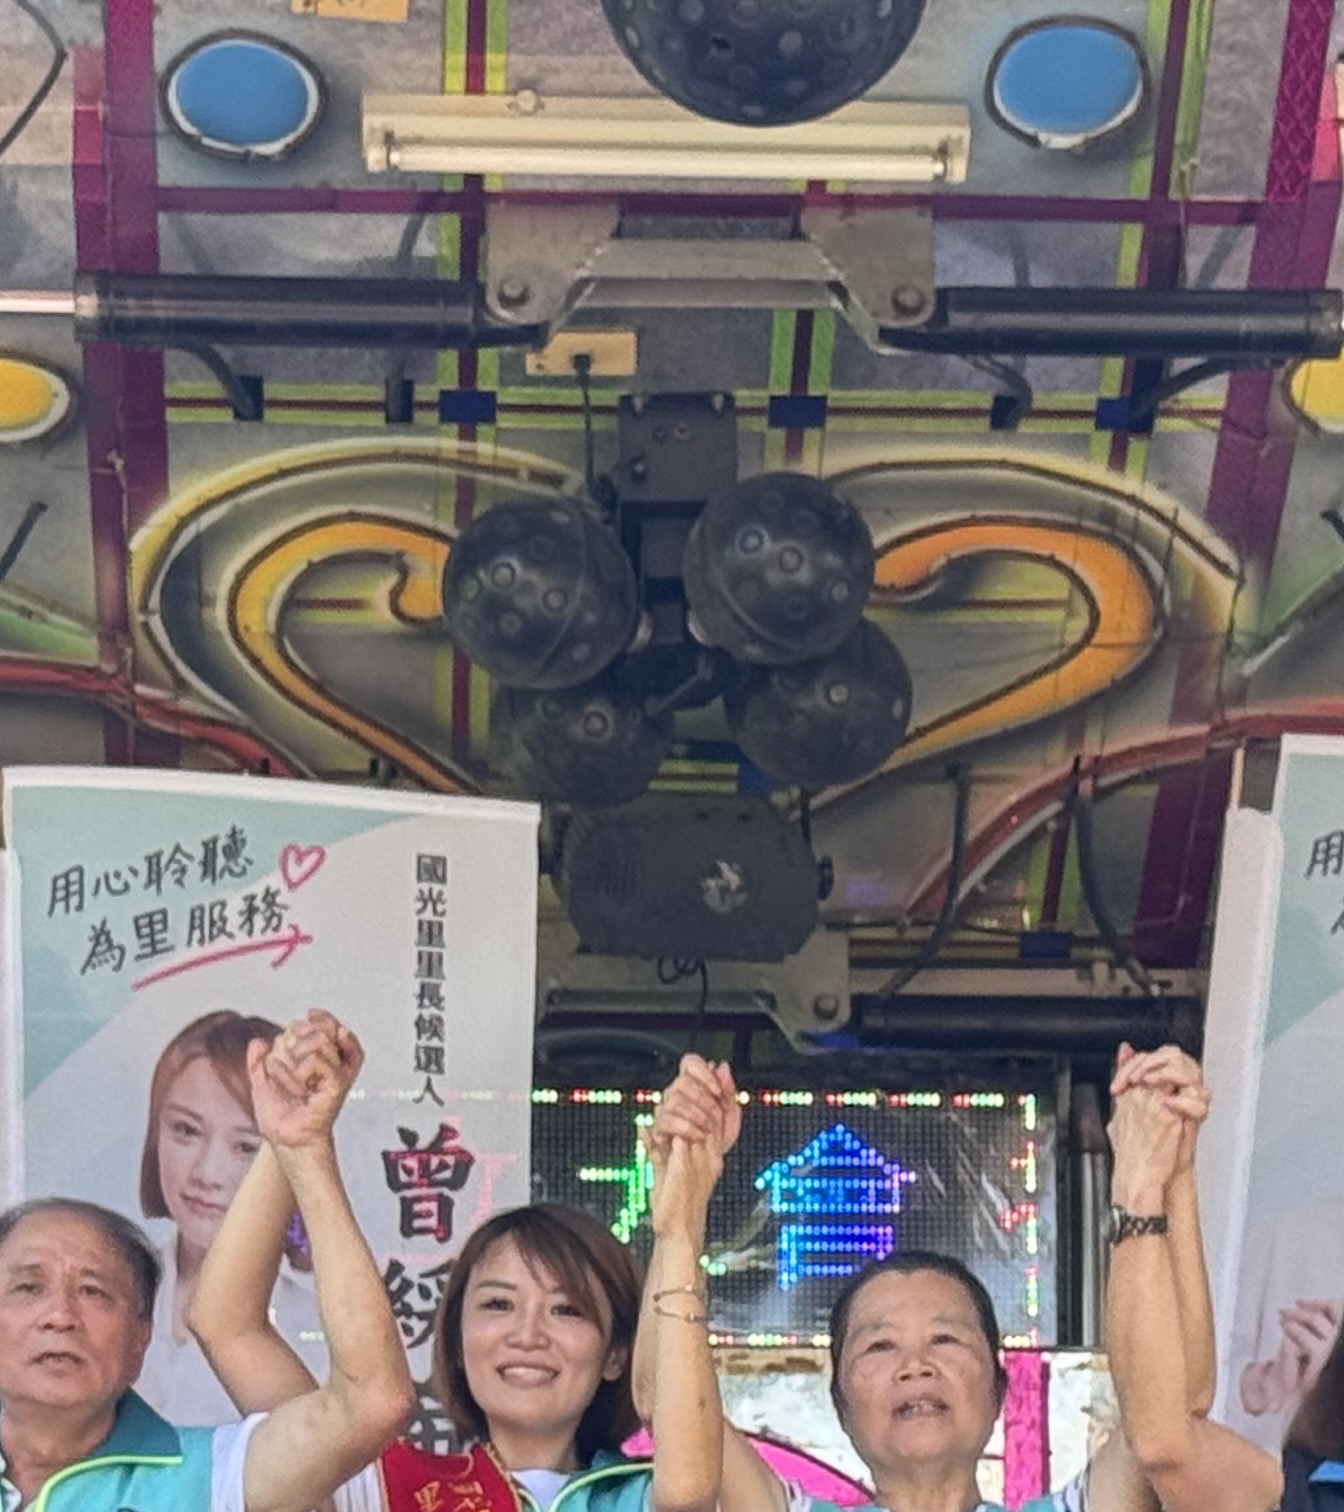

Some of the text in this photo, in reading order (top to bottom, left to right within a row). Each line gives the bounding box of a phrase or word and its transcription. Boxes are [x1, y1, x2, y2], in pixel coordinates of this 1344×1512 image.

[46, 824, 255, 918] 用心聆聽
[80, 887, 291, 975] 為里服務
[413, 853, 448, 1108] 國光里里長候選人
